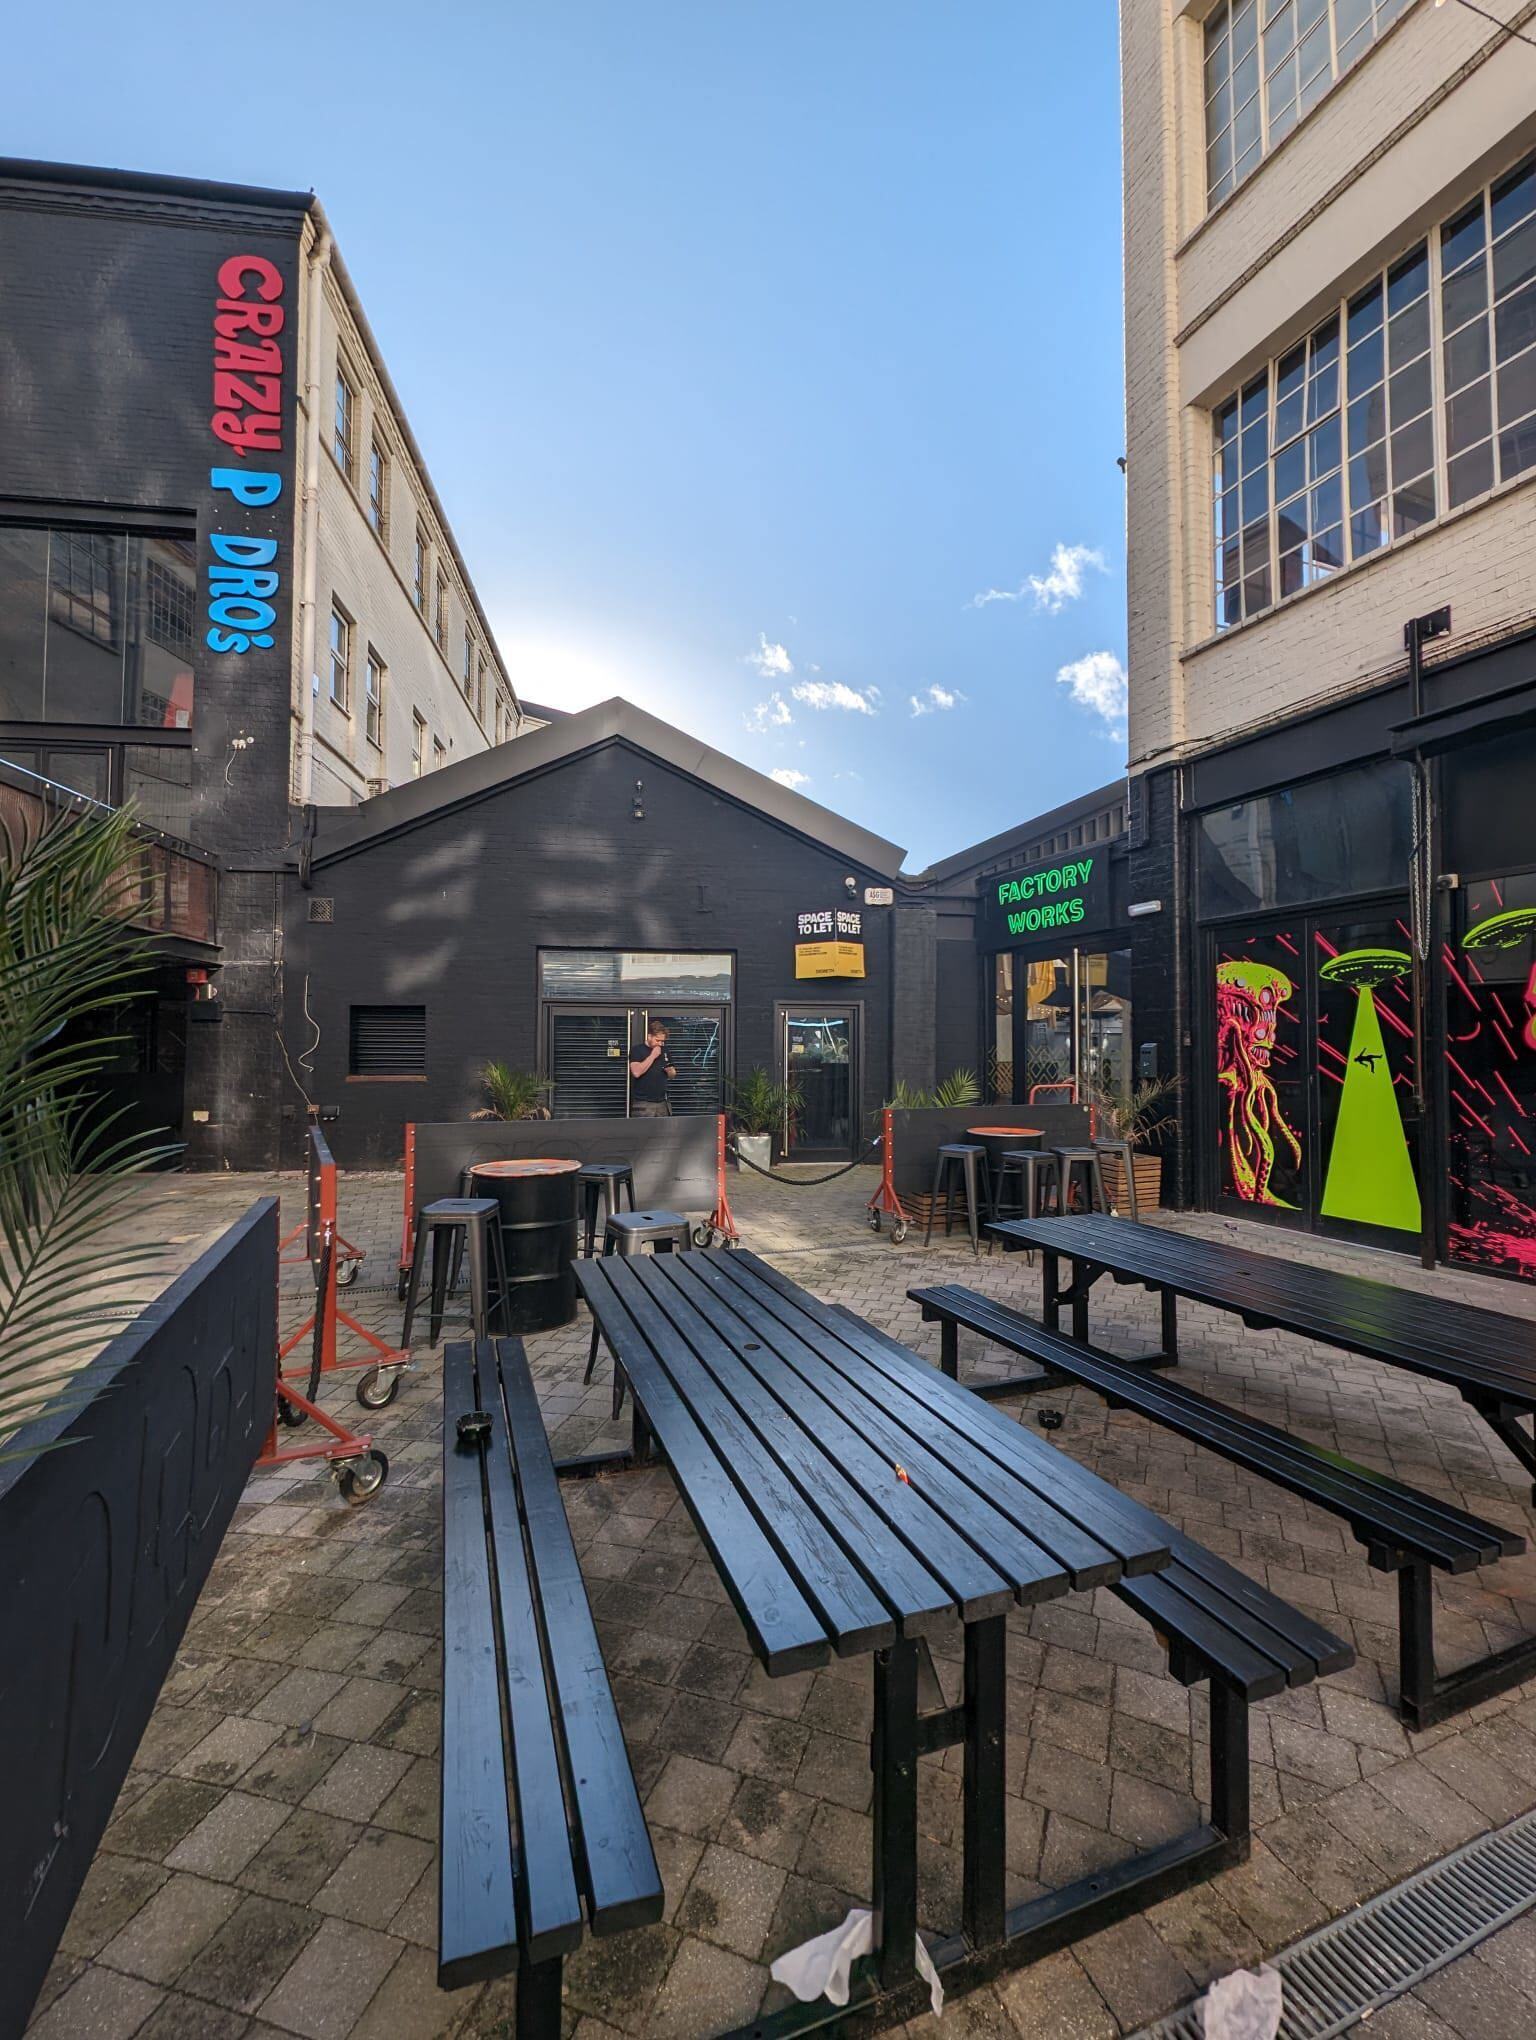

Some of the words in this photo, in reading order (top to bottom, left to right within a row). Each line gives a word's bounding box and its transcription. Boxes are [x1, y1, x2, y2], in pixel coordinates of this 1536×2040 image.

[211, 255, 284, 457] CRAZY
[998, 859, 1093, 905] FACTORY
[798, 912, 832, 924] SPACE
[837, 911, 860, 924] SPACE
[1008, 898, 1084, 934] WORKS
[798, 925, 812, 934] TO
[814, 922, 833, 933] LET
[838, 923, 847, 933] TO
[848, 924, 861, 934] LET
